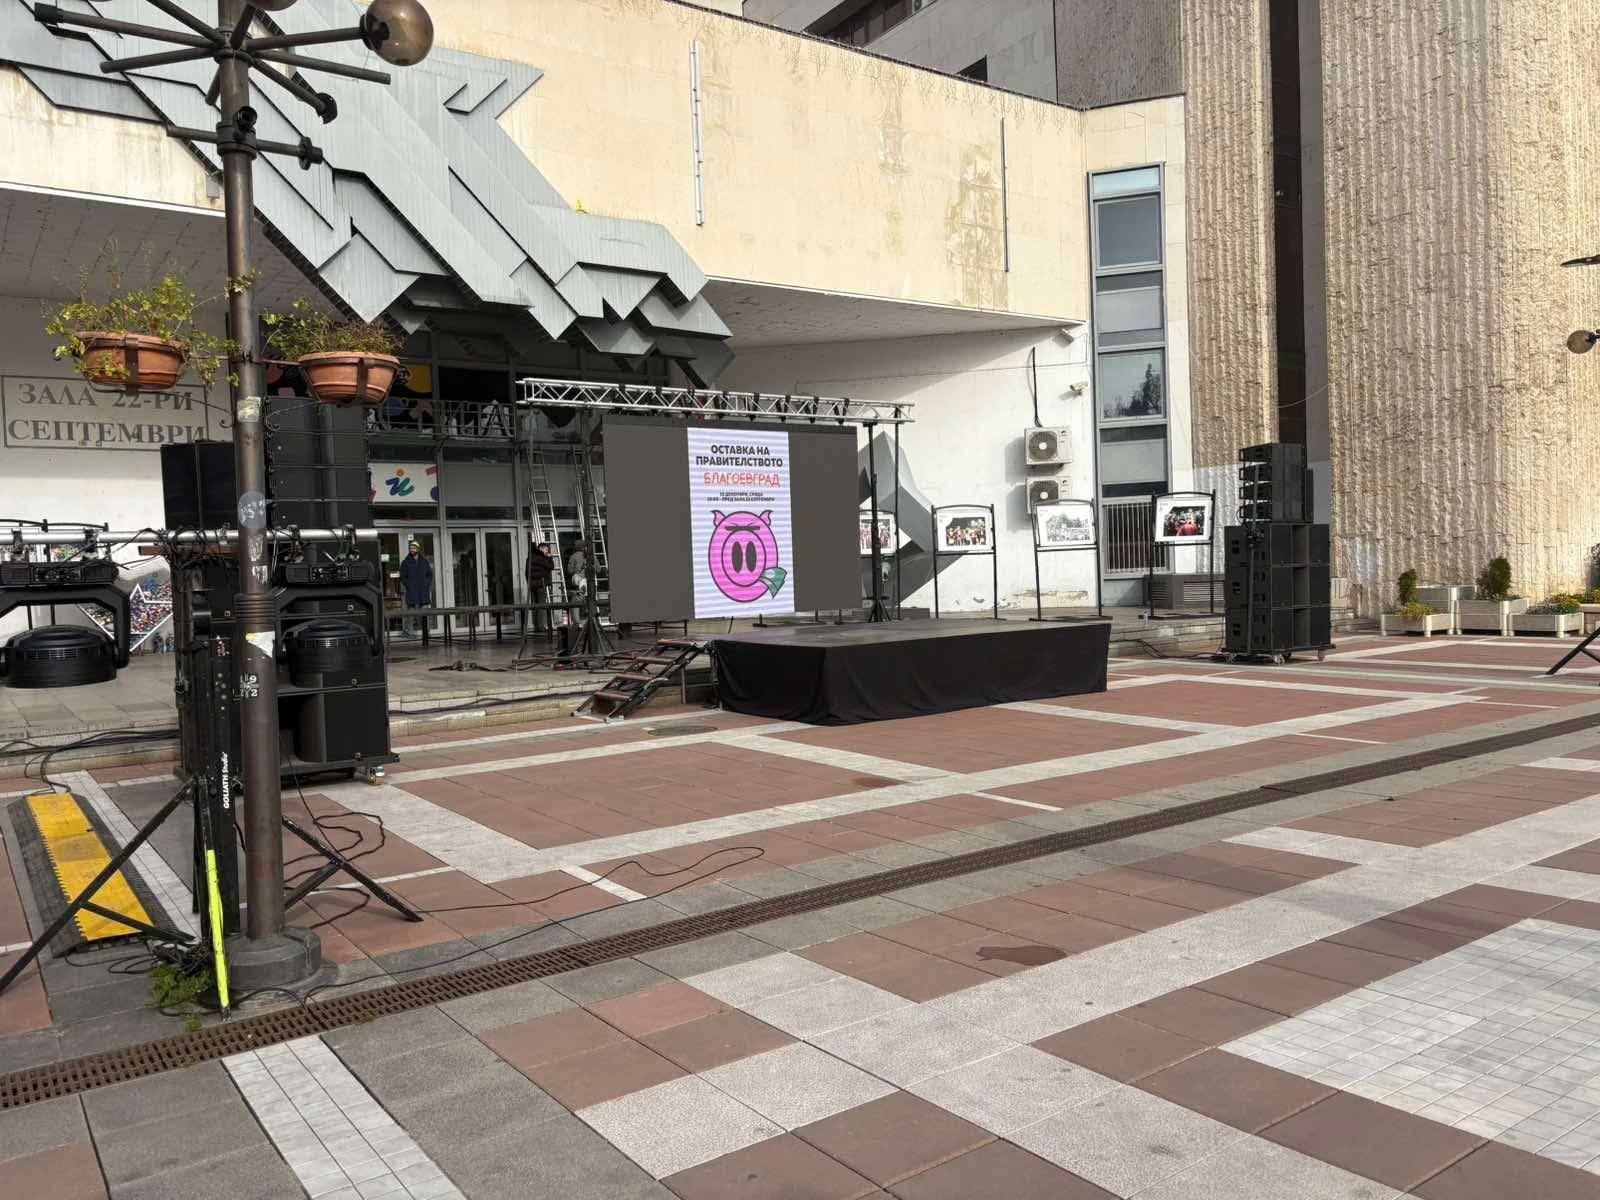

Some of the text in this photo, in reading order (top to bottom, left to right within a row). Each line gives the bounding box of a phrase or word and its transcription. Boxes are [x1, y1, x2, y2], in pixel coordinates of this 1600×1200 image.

[18, 383, 96, 406] ЗАЛА
[8, 419, 207, 444] СЕПТЕМВРИ
[711, 444, 770, 456] ОСТАВКА НА
[695, 456, 783, 467] ПРАВИТЕЛСТВОТО
[703, 472, 781, 488] БЛАГОЕВГРАД
[222, 774, 230, 809] GOLIATH
